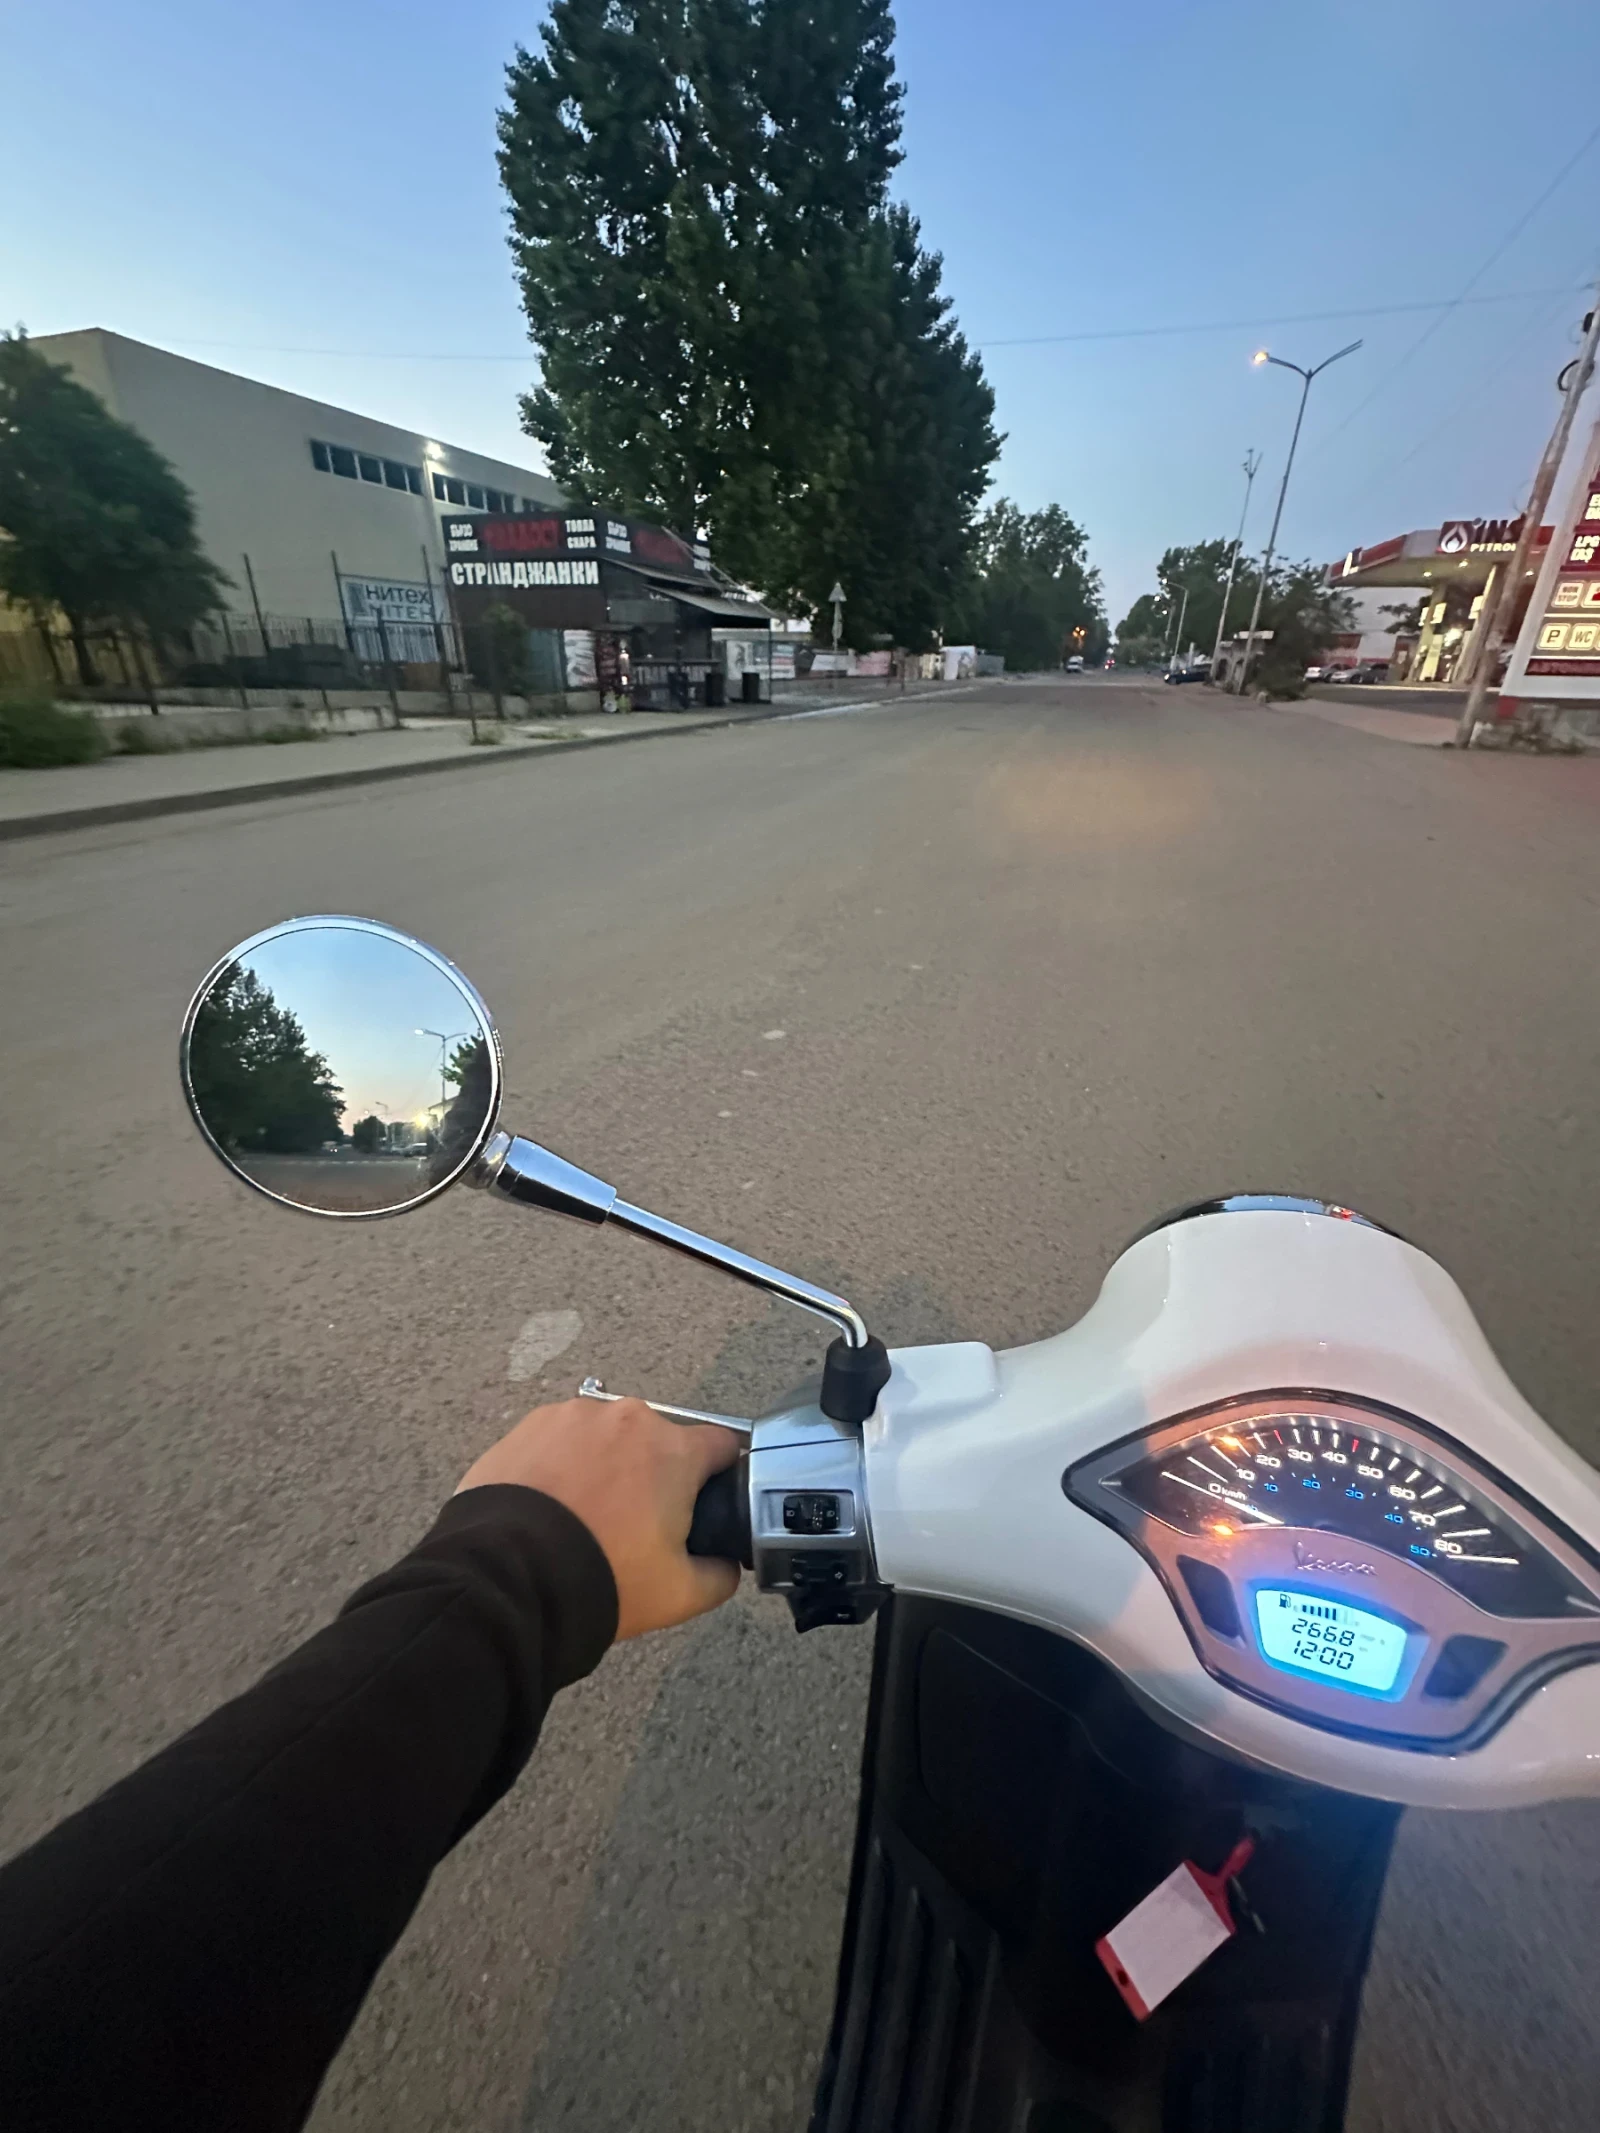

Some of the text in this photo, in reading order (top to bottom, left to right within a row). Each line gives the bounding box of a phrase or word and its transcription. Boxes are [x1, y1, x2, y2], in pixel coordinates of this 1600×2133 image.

[1547, 629, 1593, 643] P WC
[1236, 1468, 1255, 1481] 10
[1256, 1454, 1281, 1468] 20
[1287, 1448, 1313, 1463] 30
[1321, 1451, 1347, 1465] 40
[1357, 1464, 1384, 1480] 50
[1389, 1485, 1416, 1500] 60
[1408, 1510, 1436, 1527] 70
[1434, 1539, 1462, 1554] 80
[1264, 1479, 1430, 1557] 10 20 30 40 50
[1293, 1640, 1355, 1671] 12:00
